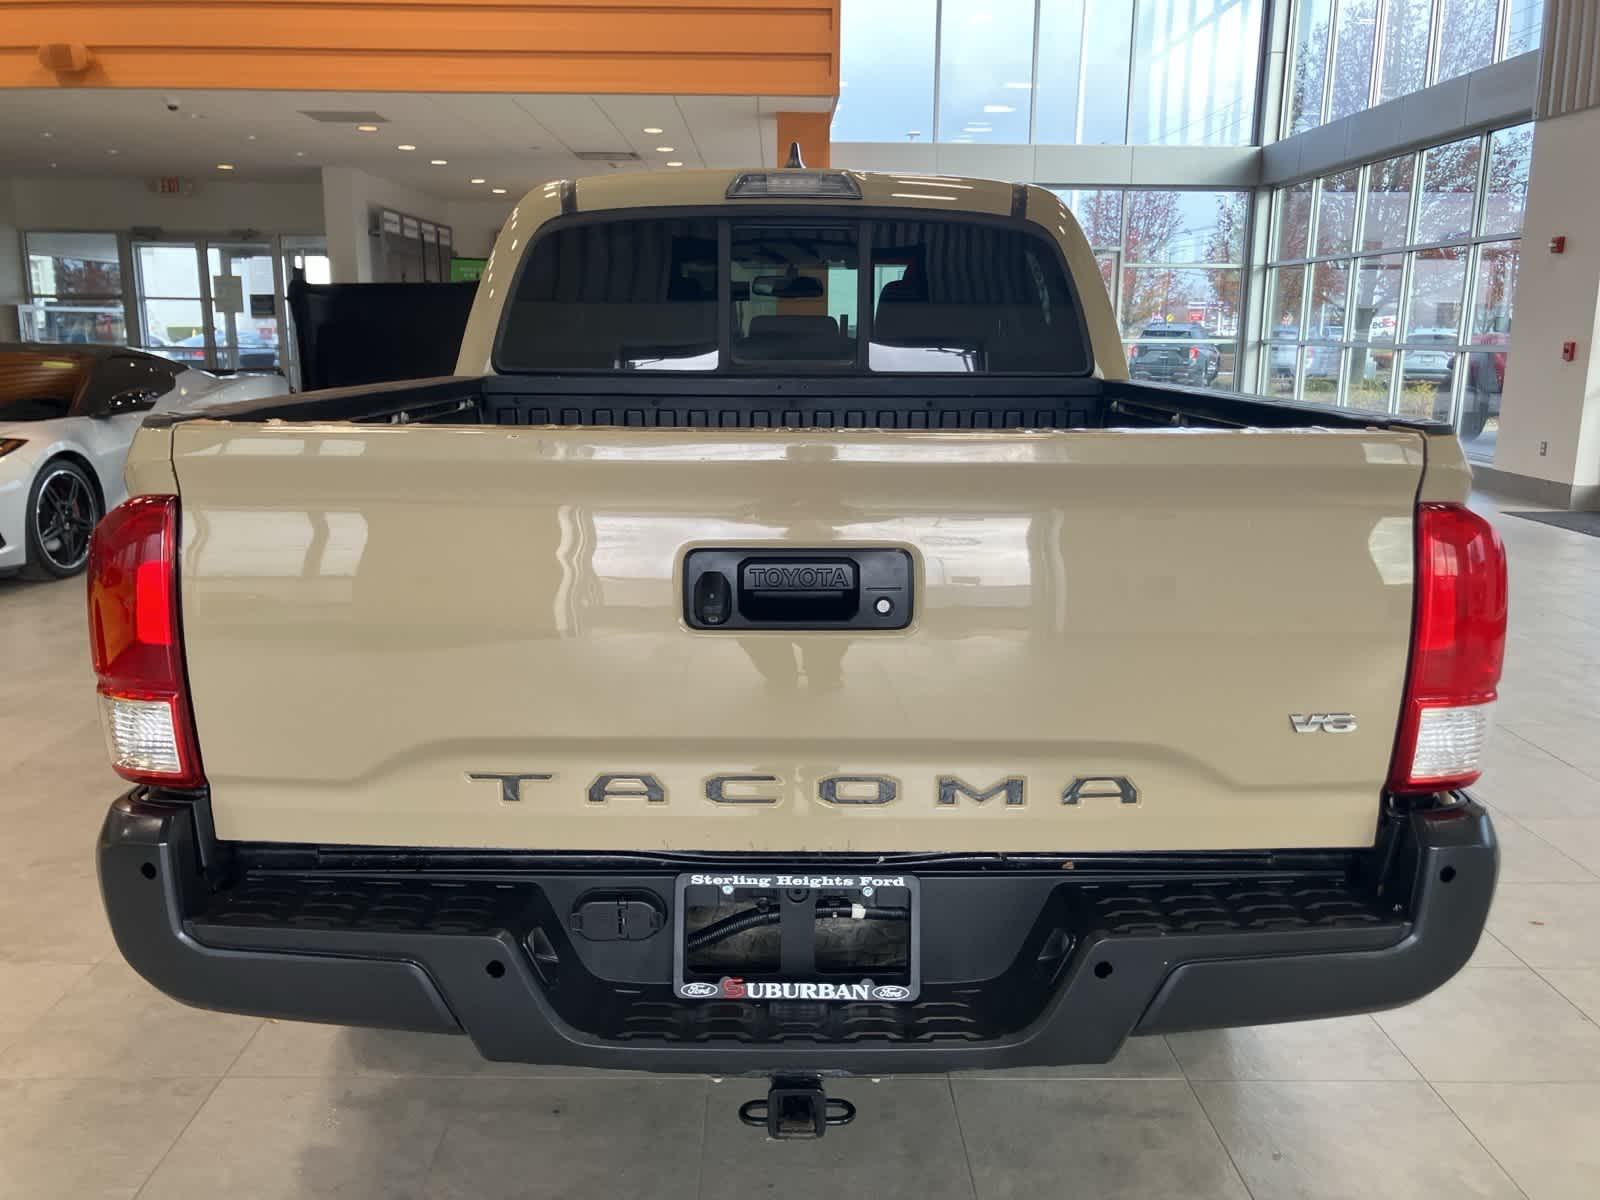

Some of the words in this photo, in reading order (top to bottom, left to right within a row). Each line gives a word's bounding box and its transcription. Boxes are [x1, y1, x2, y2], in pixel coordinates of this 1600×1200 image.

[749, 567, 849, 588] TOYOTA
[1288, 712, 1357, 733] V6
[467, 773, 1138, 806] TACOMA
[691, 874, 772, 888] Sterling
[776, 875, 853, 888] Heights
[859, 876, 905, 887] Ford
[686, 983, 712, 995] Ford
[723, 977, 869, 999] SUBURBAN
[879, 987, 903, 998] Ford
